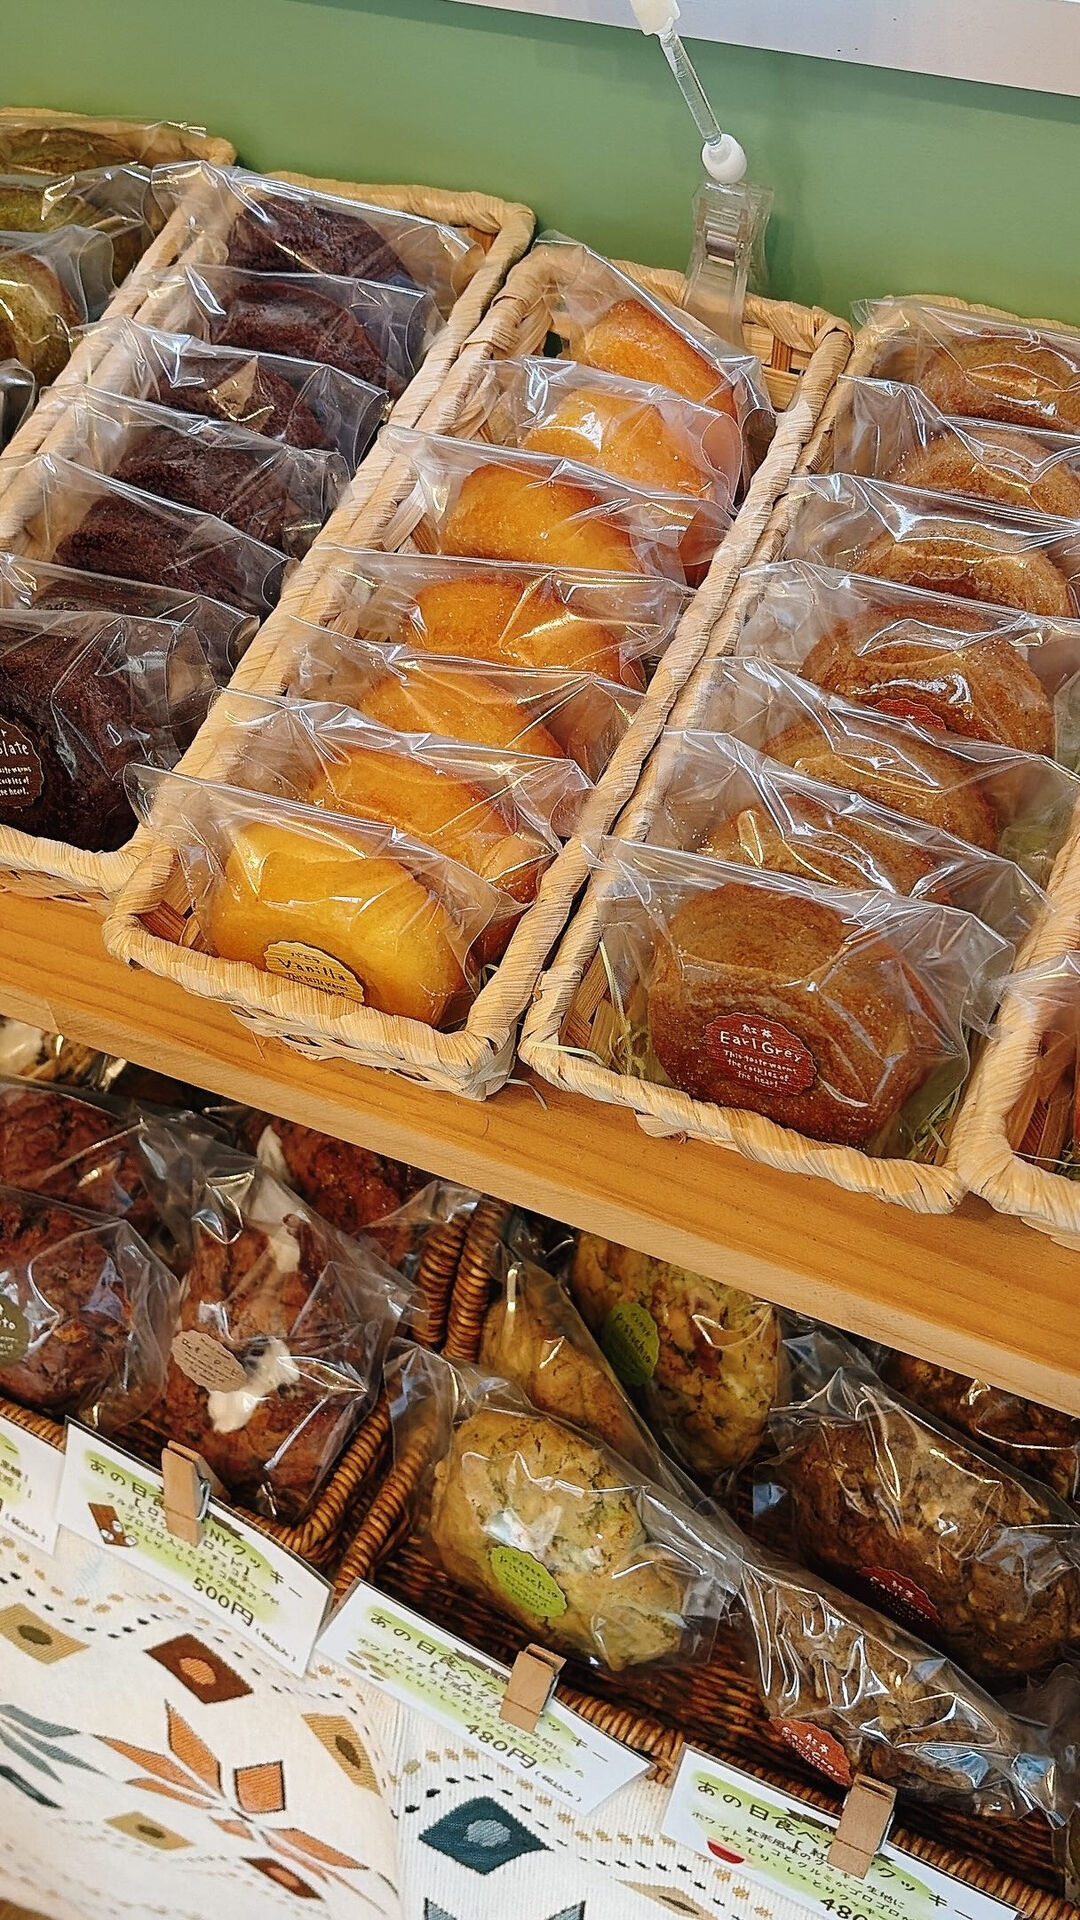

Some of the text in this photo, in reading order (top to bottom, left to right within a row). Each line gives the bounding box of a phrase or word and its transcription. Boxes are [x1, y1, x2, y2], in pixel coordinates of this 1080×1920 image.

[277, 957, 346, 981] Vanilla
[720, 1030, 802, 1062] Earl Grey
[723, 1049, 742, 1060] This
[192, 1576, 255, 1627] 500円
[465, 1723, 537, 1769] 480円
